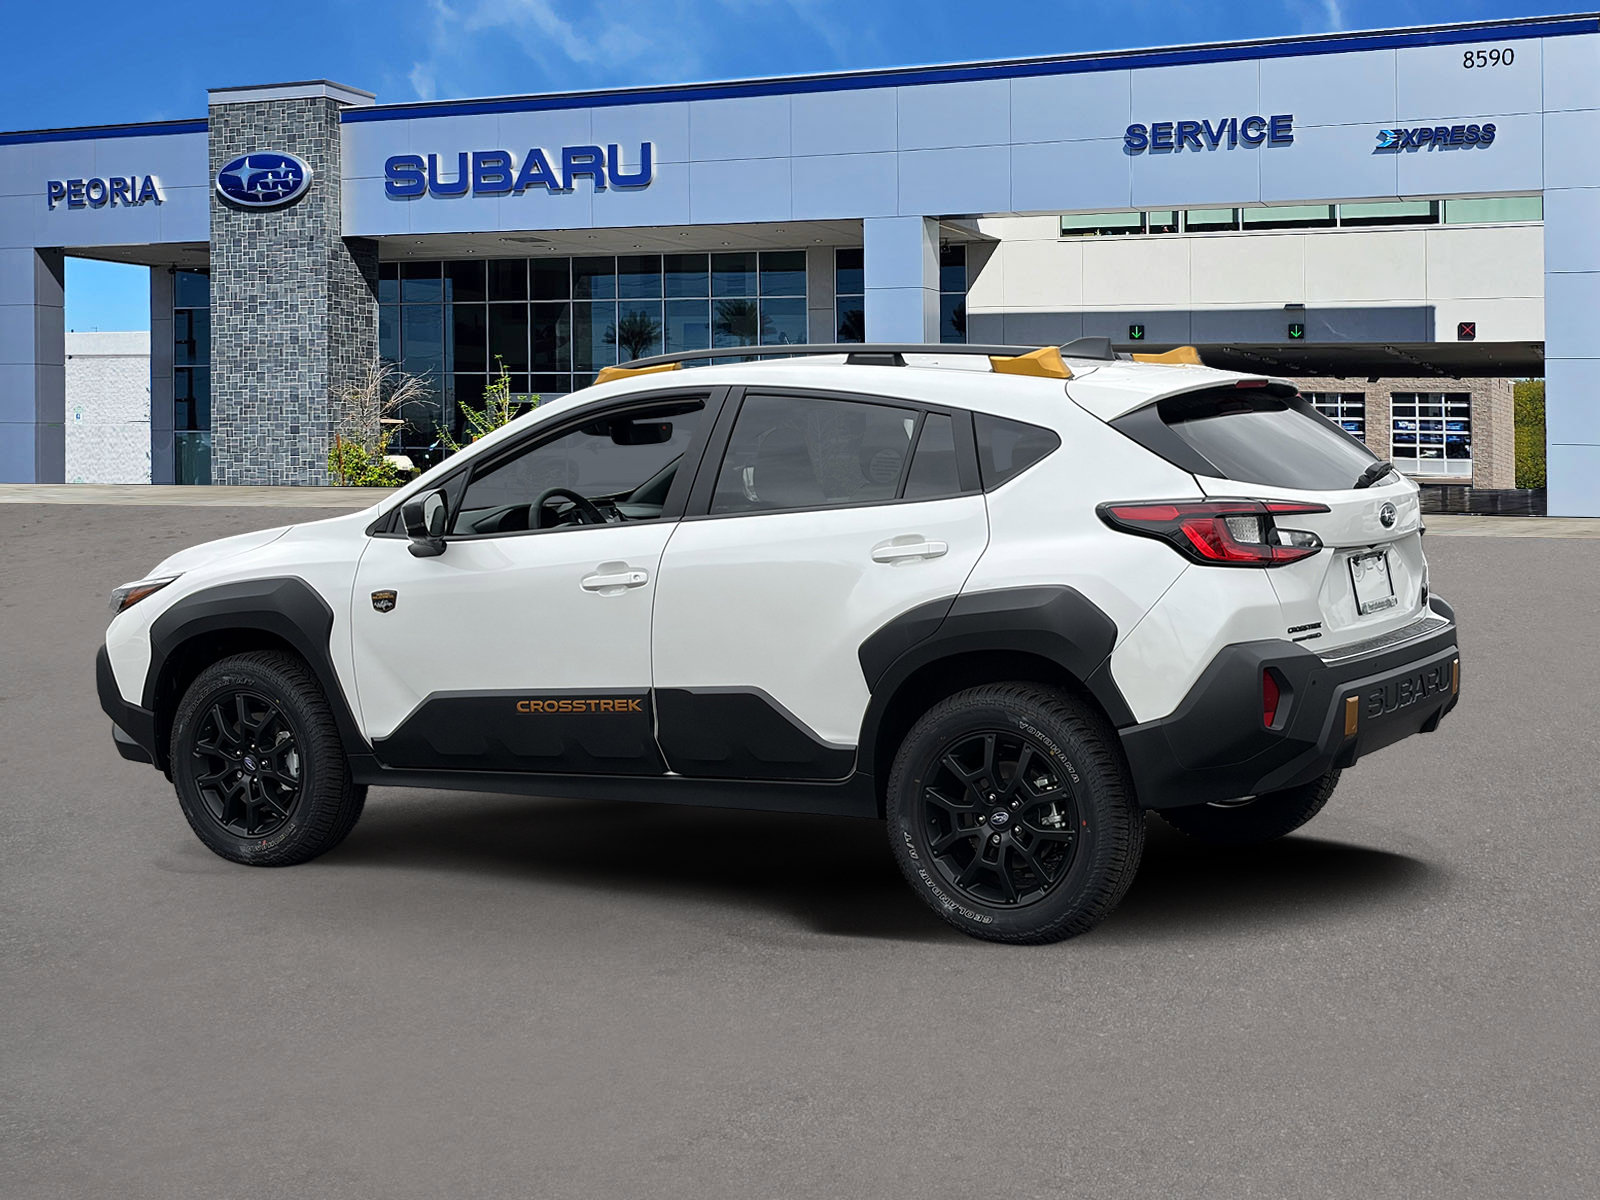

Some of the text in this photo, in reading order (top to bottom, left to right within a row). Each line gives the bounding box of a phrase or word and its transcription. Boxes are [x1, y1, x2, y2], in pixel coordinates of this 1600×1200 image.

[1463, 48, 1515, 69] 8590
[1124, 114, 1294, 151] SERVICE
[384, 142, 653, 199] SUBARU
[47, 175, 162, 209] PEORIA
[515, 698, 643, 713] CROSSTREK
[1367, 661, 1451, 719] SUBARU
[1019, 721, 1080, 783] YOKOHAMA
